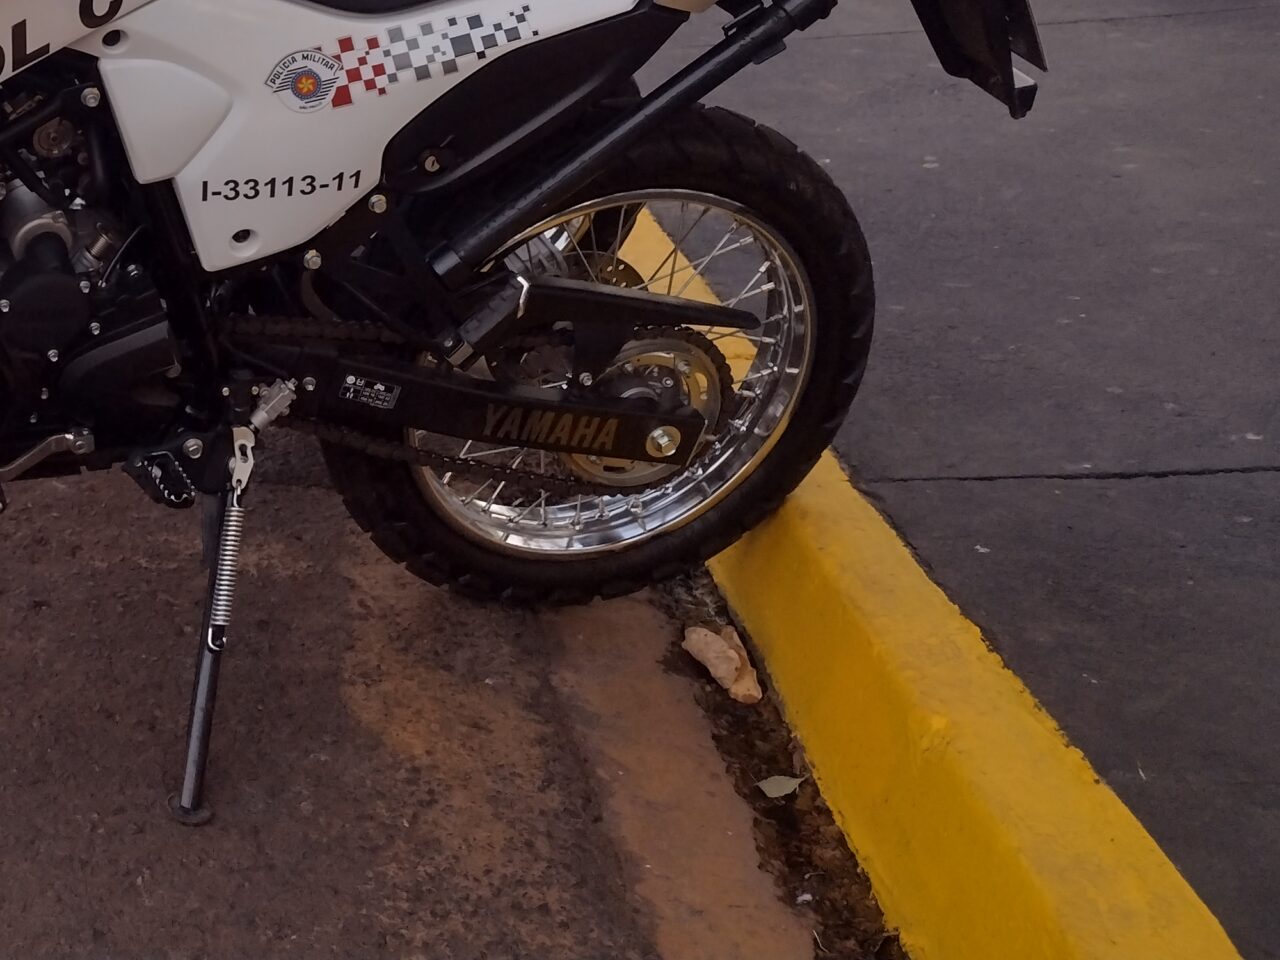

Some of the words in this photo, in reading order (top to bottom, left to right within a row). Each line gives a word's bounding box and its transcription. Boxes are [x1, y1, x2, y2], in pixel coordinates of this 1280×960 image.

[301, 53, 336, 71] MILITAR
[202, 170, 362, 202] I-33113-11
[482, 403, 621, 451] YAMAHA
